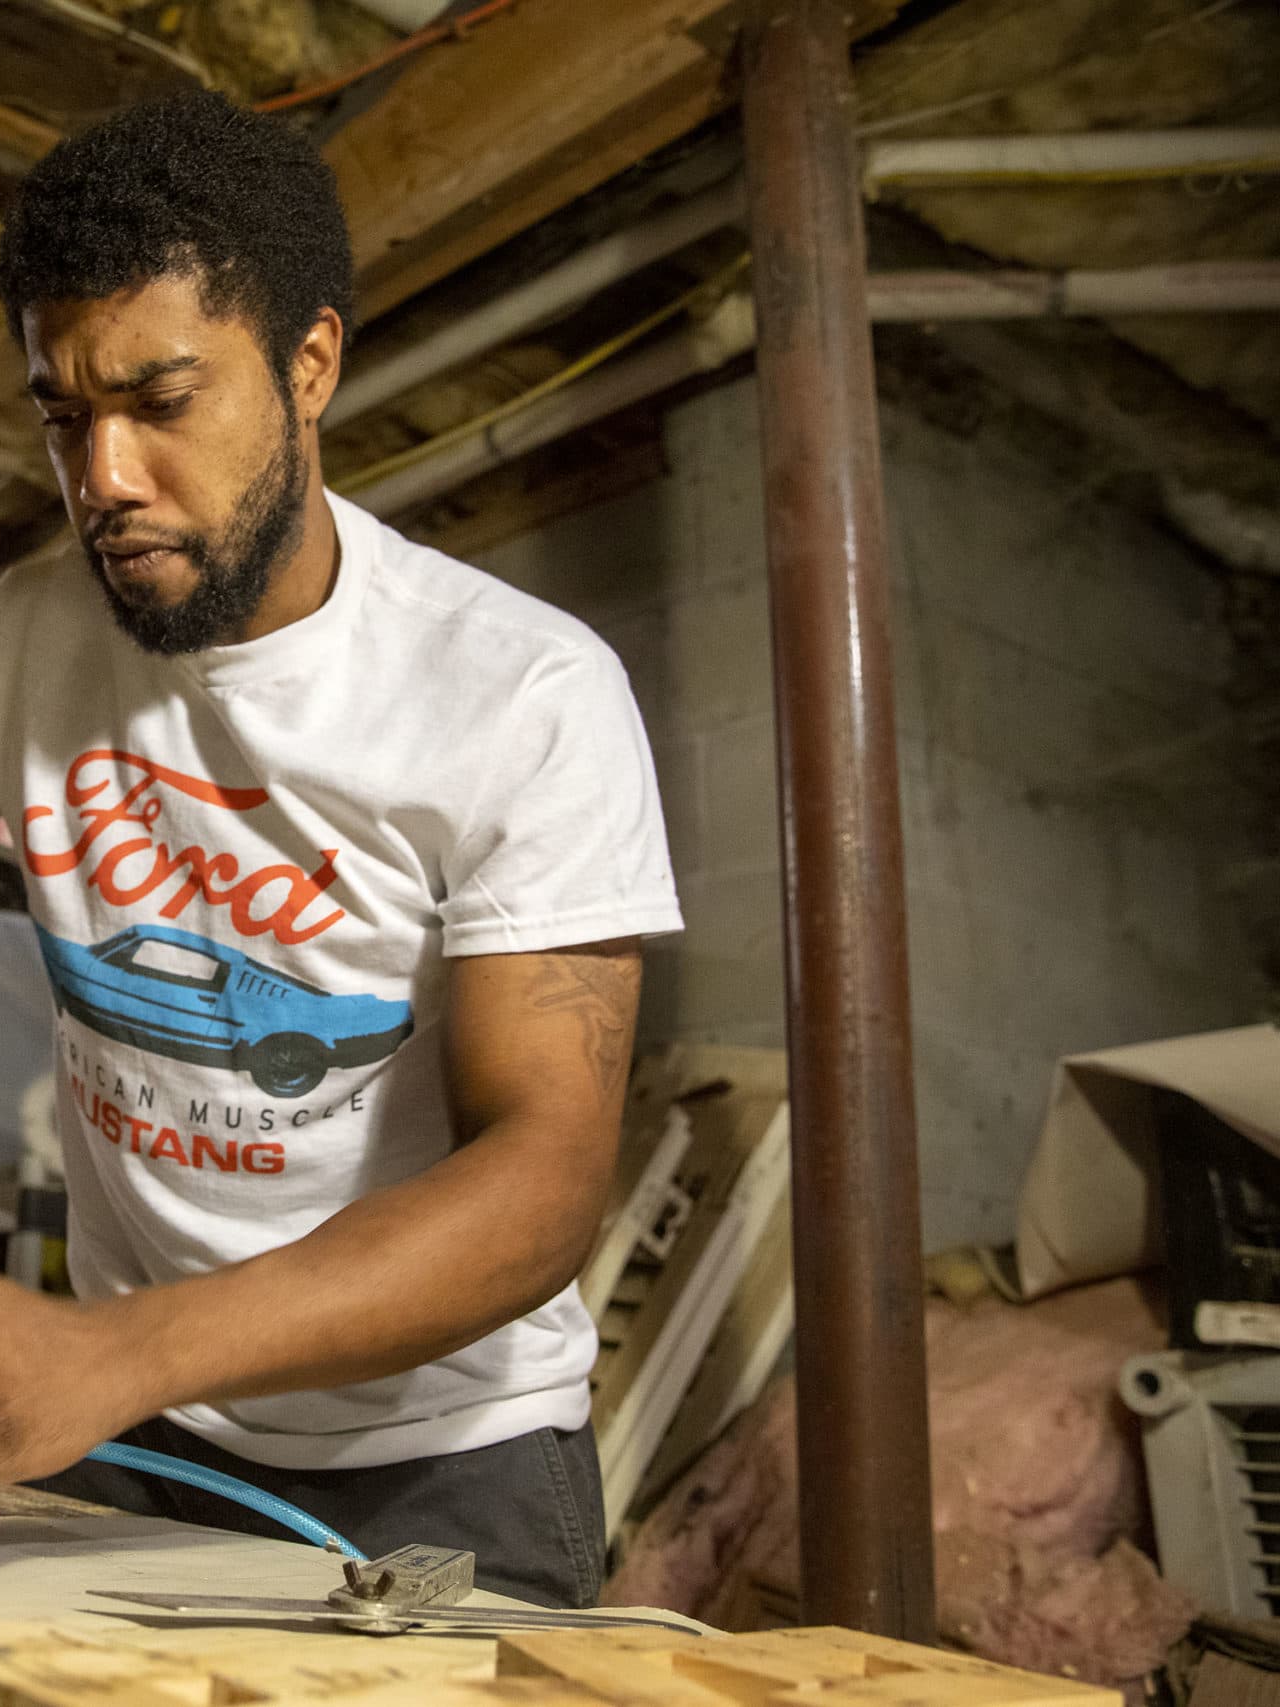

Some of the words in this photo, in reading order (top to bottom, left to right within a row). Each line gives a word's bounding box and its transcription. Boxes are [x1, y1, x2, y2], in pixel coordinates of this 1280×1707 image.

[23, 749, 345, 945] Ford
[61, 1031, 154, 1109] RICAN
[189, 1088, 363, 1131] MUSCLE
